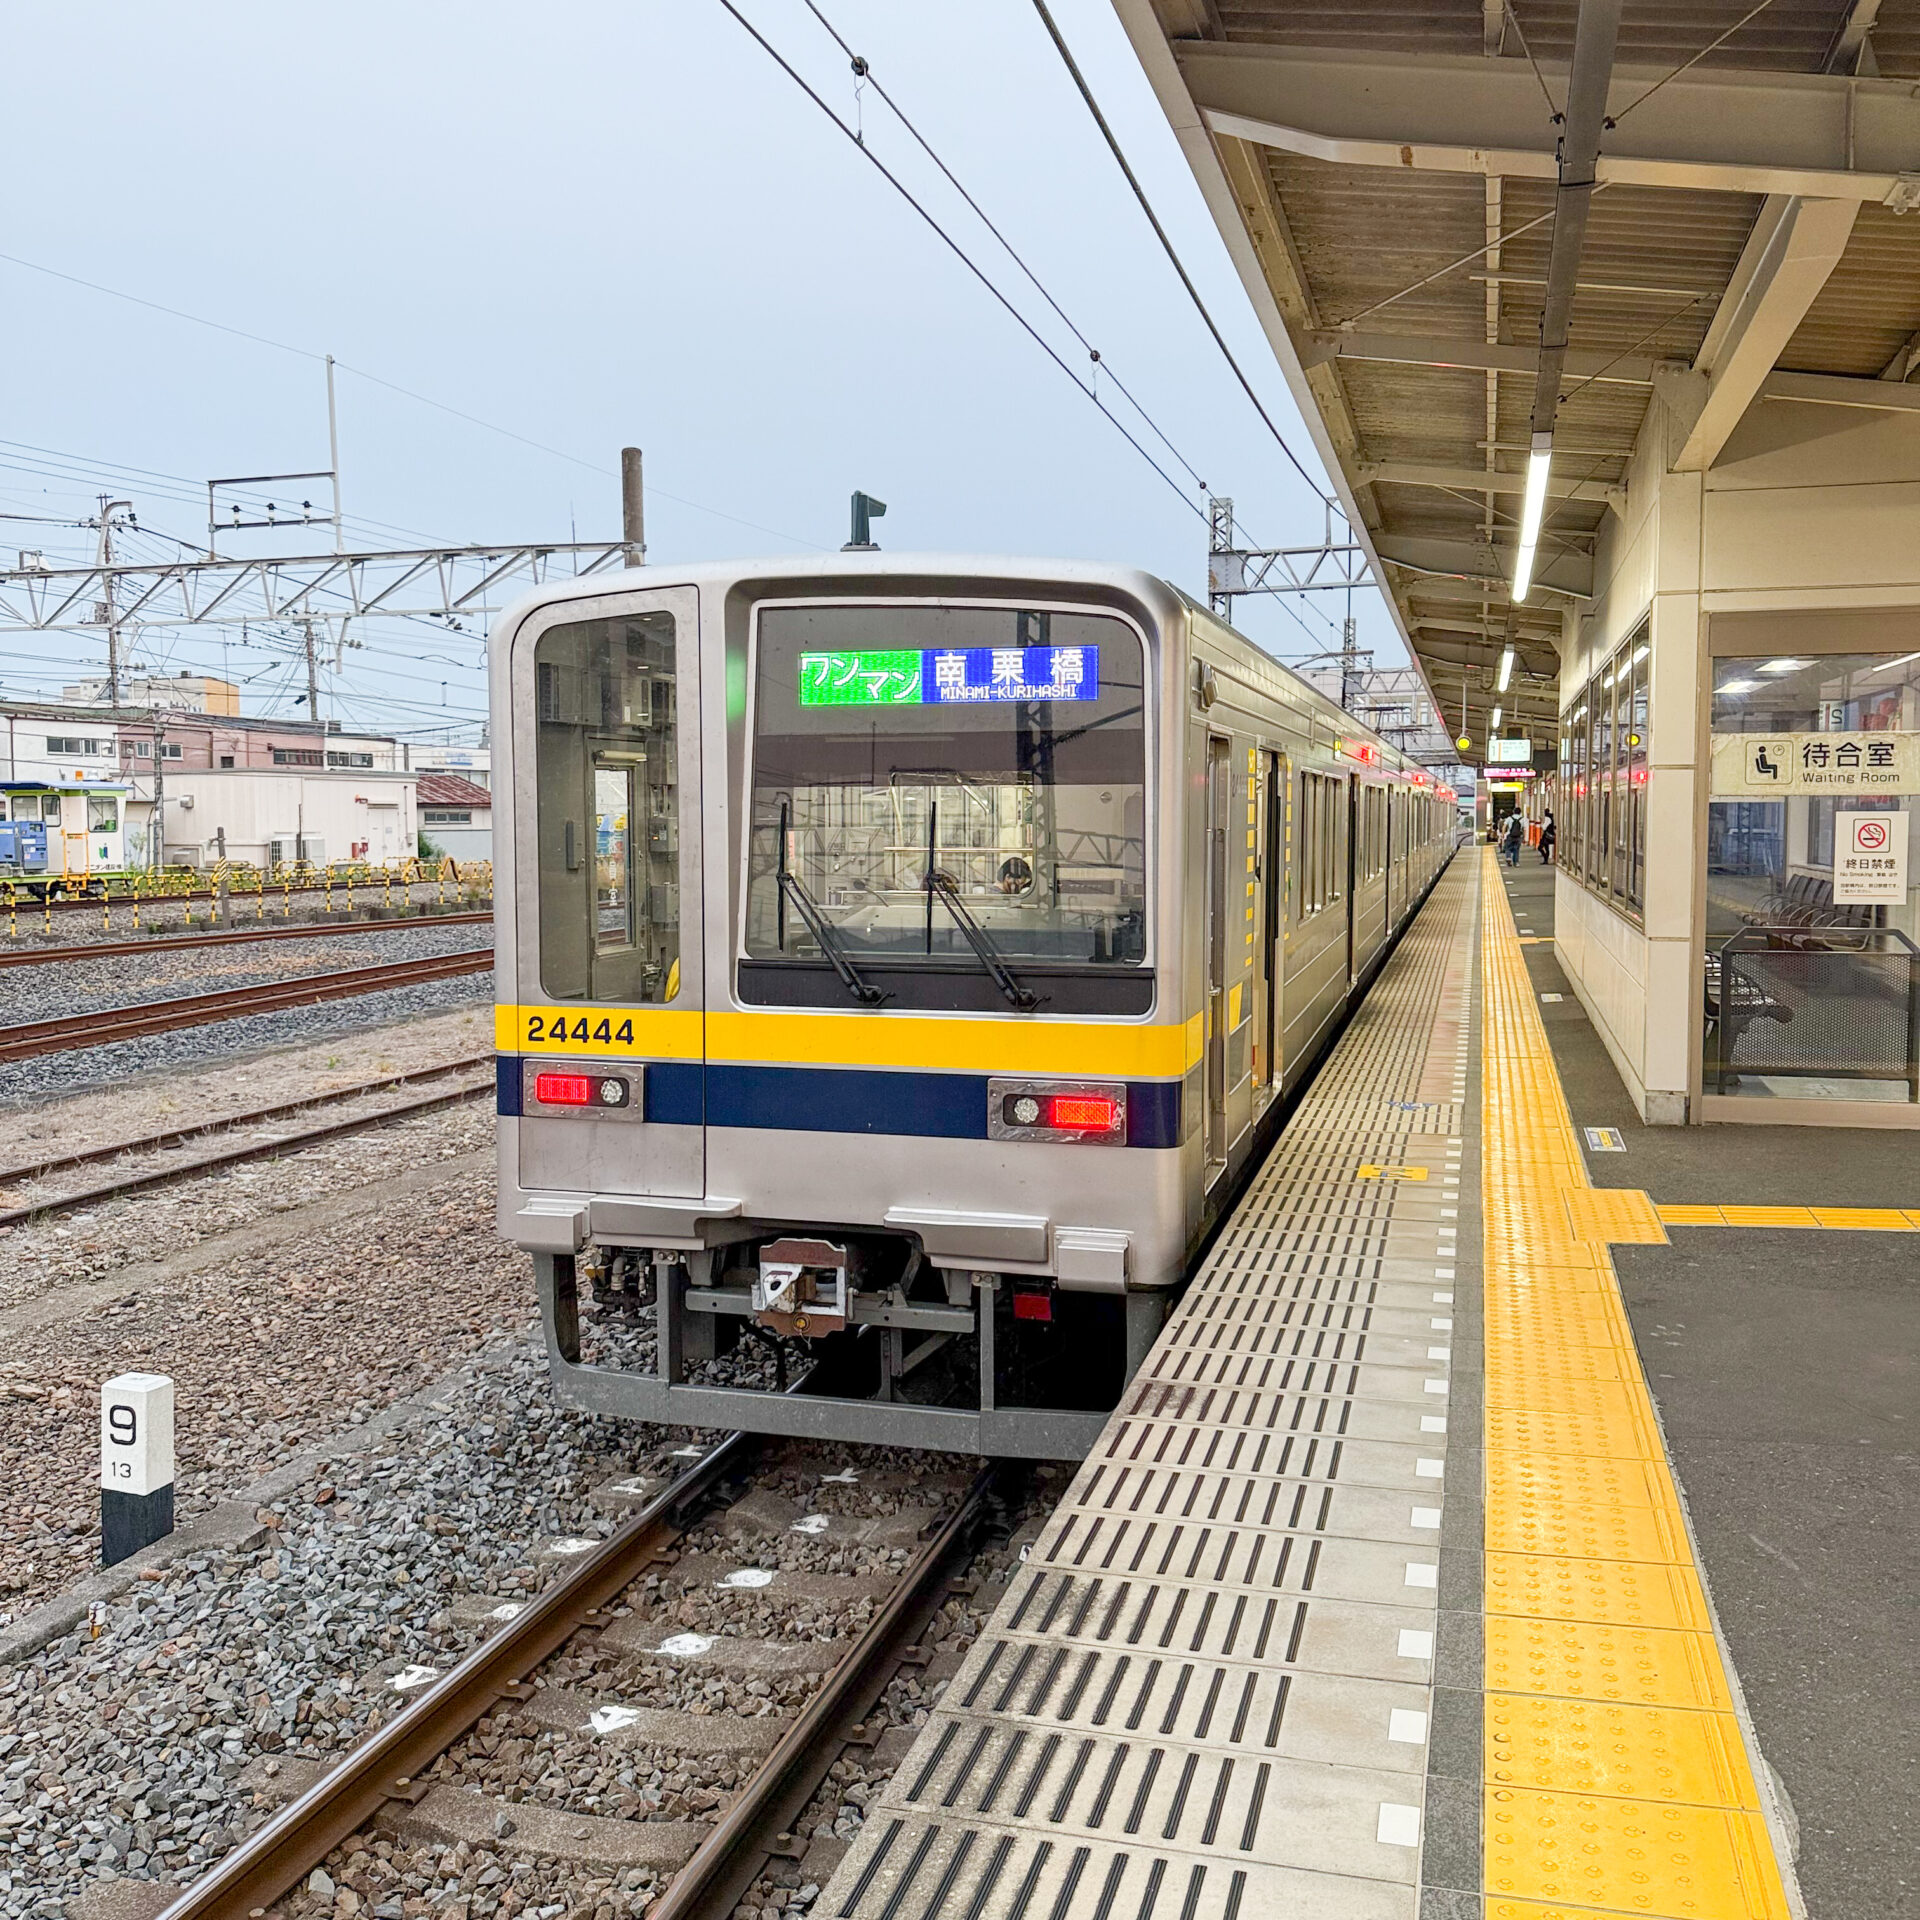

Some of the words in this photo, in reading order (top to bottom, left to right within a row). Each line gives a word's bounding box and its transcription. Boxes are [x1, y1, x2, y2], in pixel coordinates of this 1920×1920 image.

[801, 656, 920, 699] ワンマン
[934, 648, 1084, 687] 南栗橋
[941, 684, 1077, 700] MINAMI-KURIHASHI
[1802, 741, 1895, 768] 待合室
[1802, 772, 1855, 784] Waiting
[1860, 772, 1900, 783] Room
[1846, 858, 1896, 869] 終日禁煙
[527, 1016, 635, 1046] 24444
[109, 1404, 137, 1446] 9
[111, 1461, 132, 1479] 13
